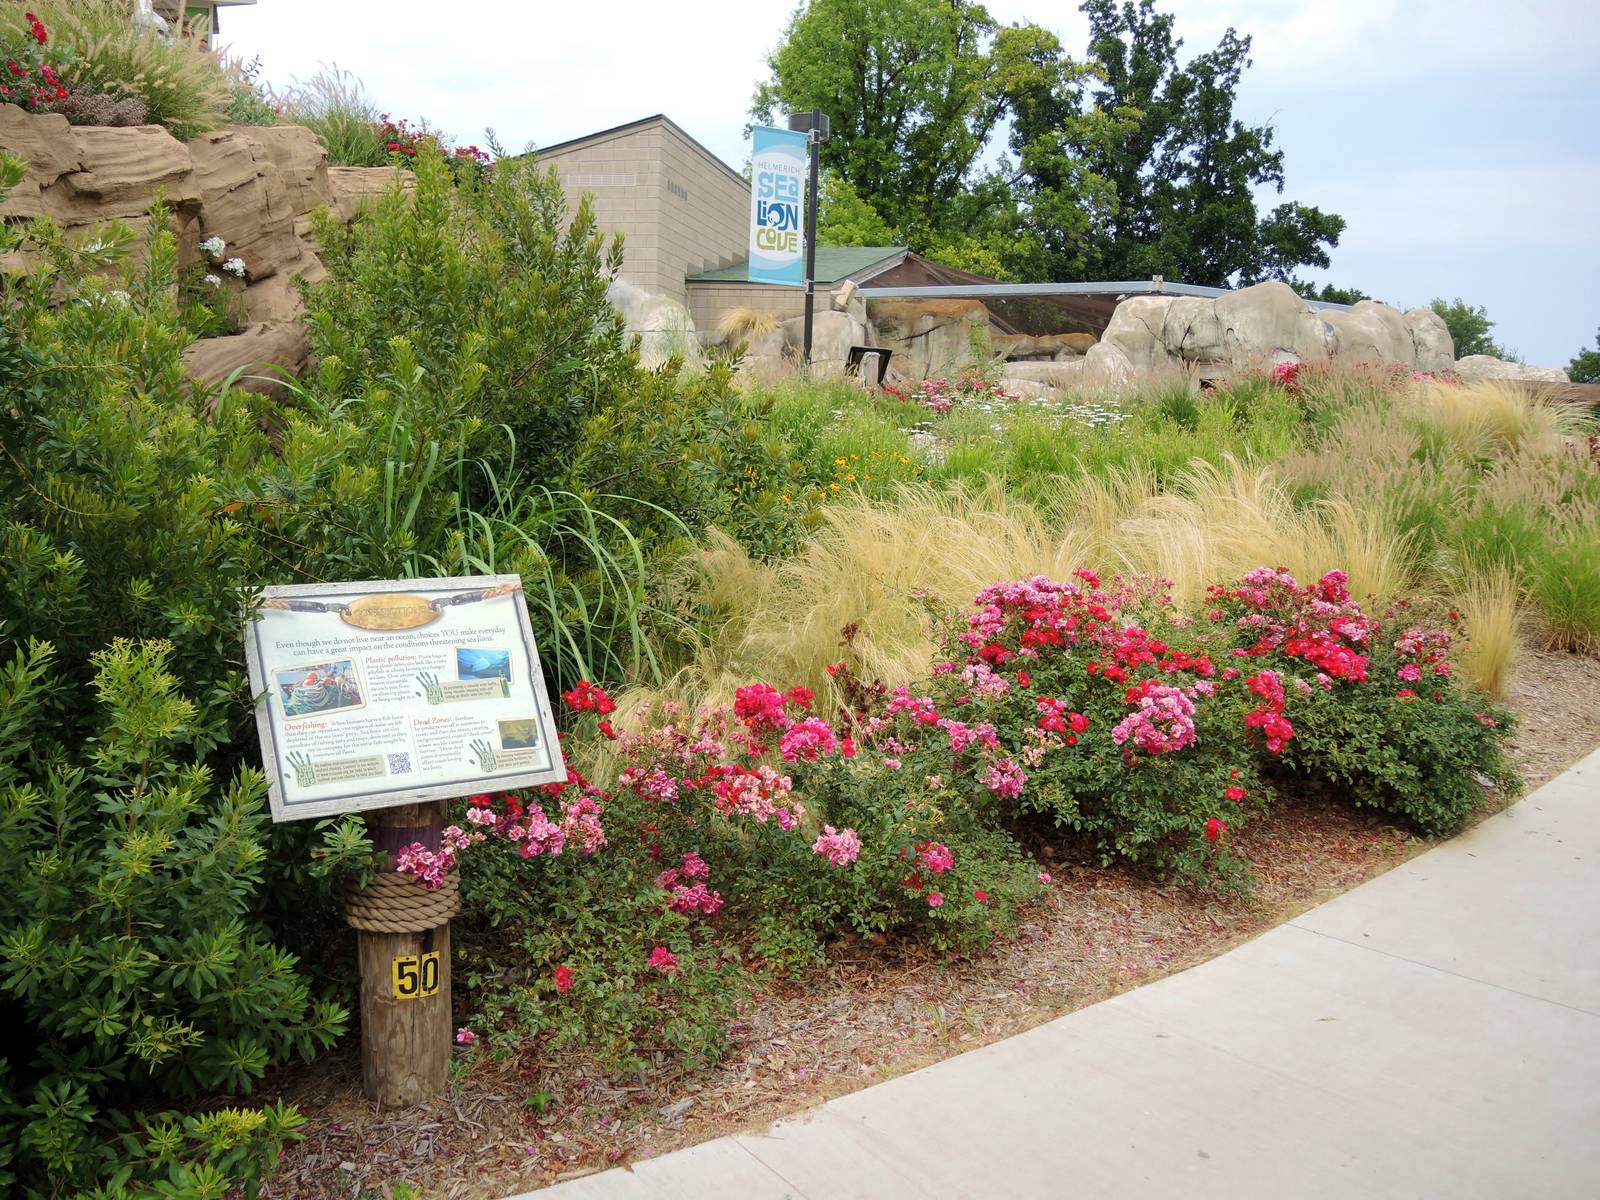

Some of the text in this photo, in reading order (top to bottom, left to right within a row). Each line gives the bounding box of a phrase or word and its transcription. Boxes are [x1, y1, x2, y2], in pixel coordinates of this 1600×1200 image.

[759, 161, 800, 173] HELMERICH
[296, 640, 320, 648] though
[441, 629, 458, 637] YOU
[478, 626, 505, 635] everyday
[349, 645, 372, 653] impact
[395, 640, 428, 648] conditions
[430, 636, 466, 646] threatening
[388, 655, 416, 663] pollution:
[284, 722, 327, 732] Overfishing:
[414, 716, 430, 726] Dead
[398, 957, 438, 995] 50
